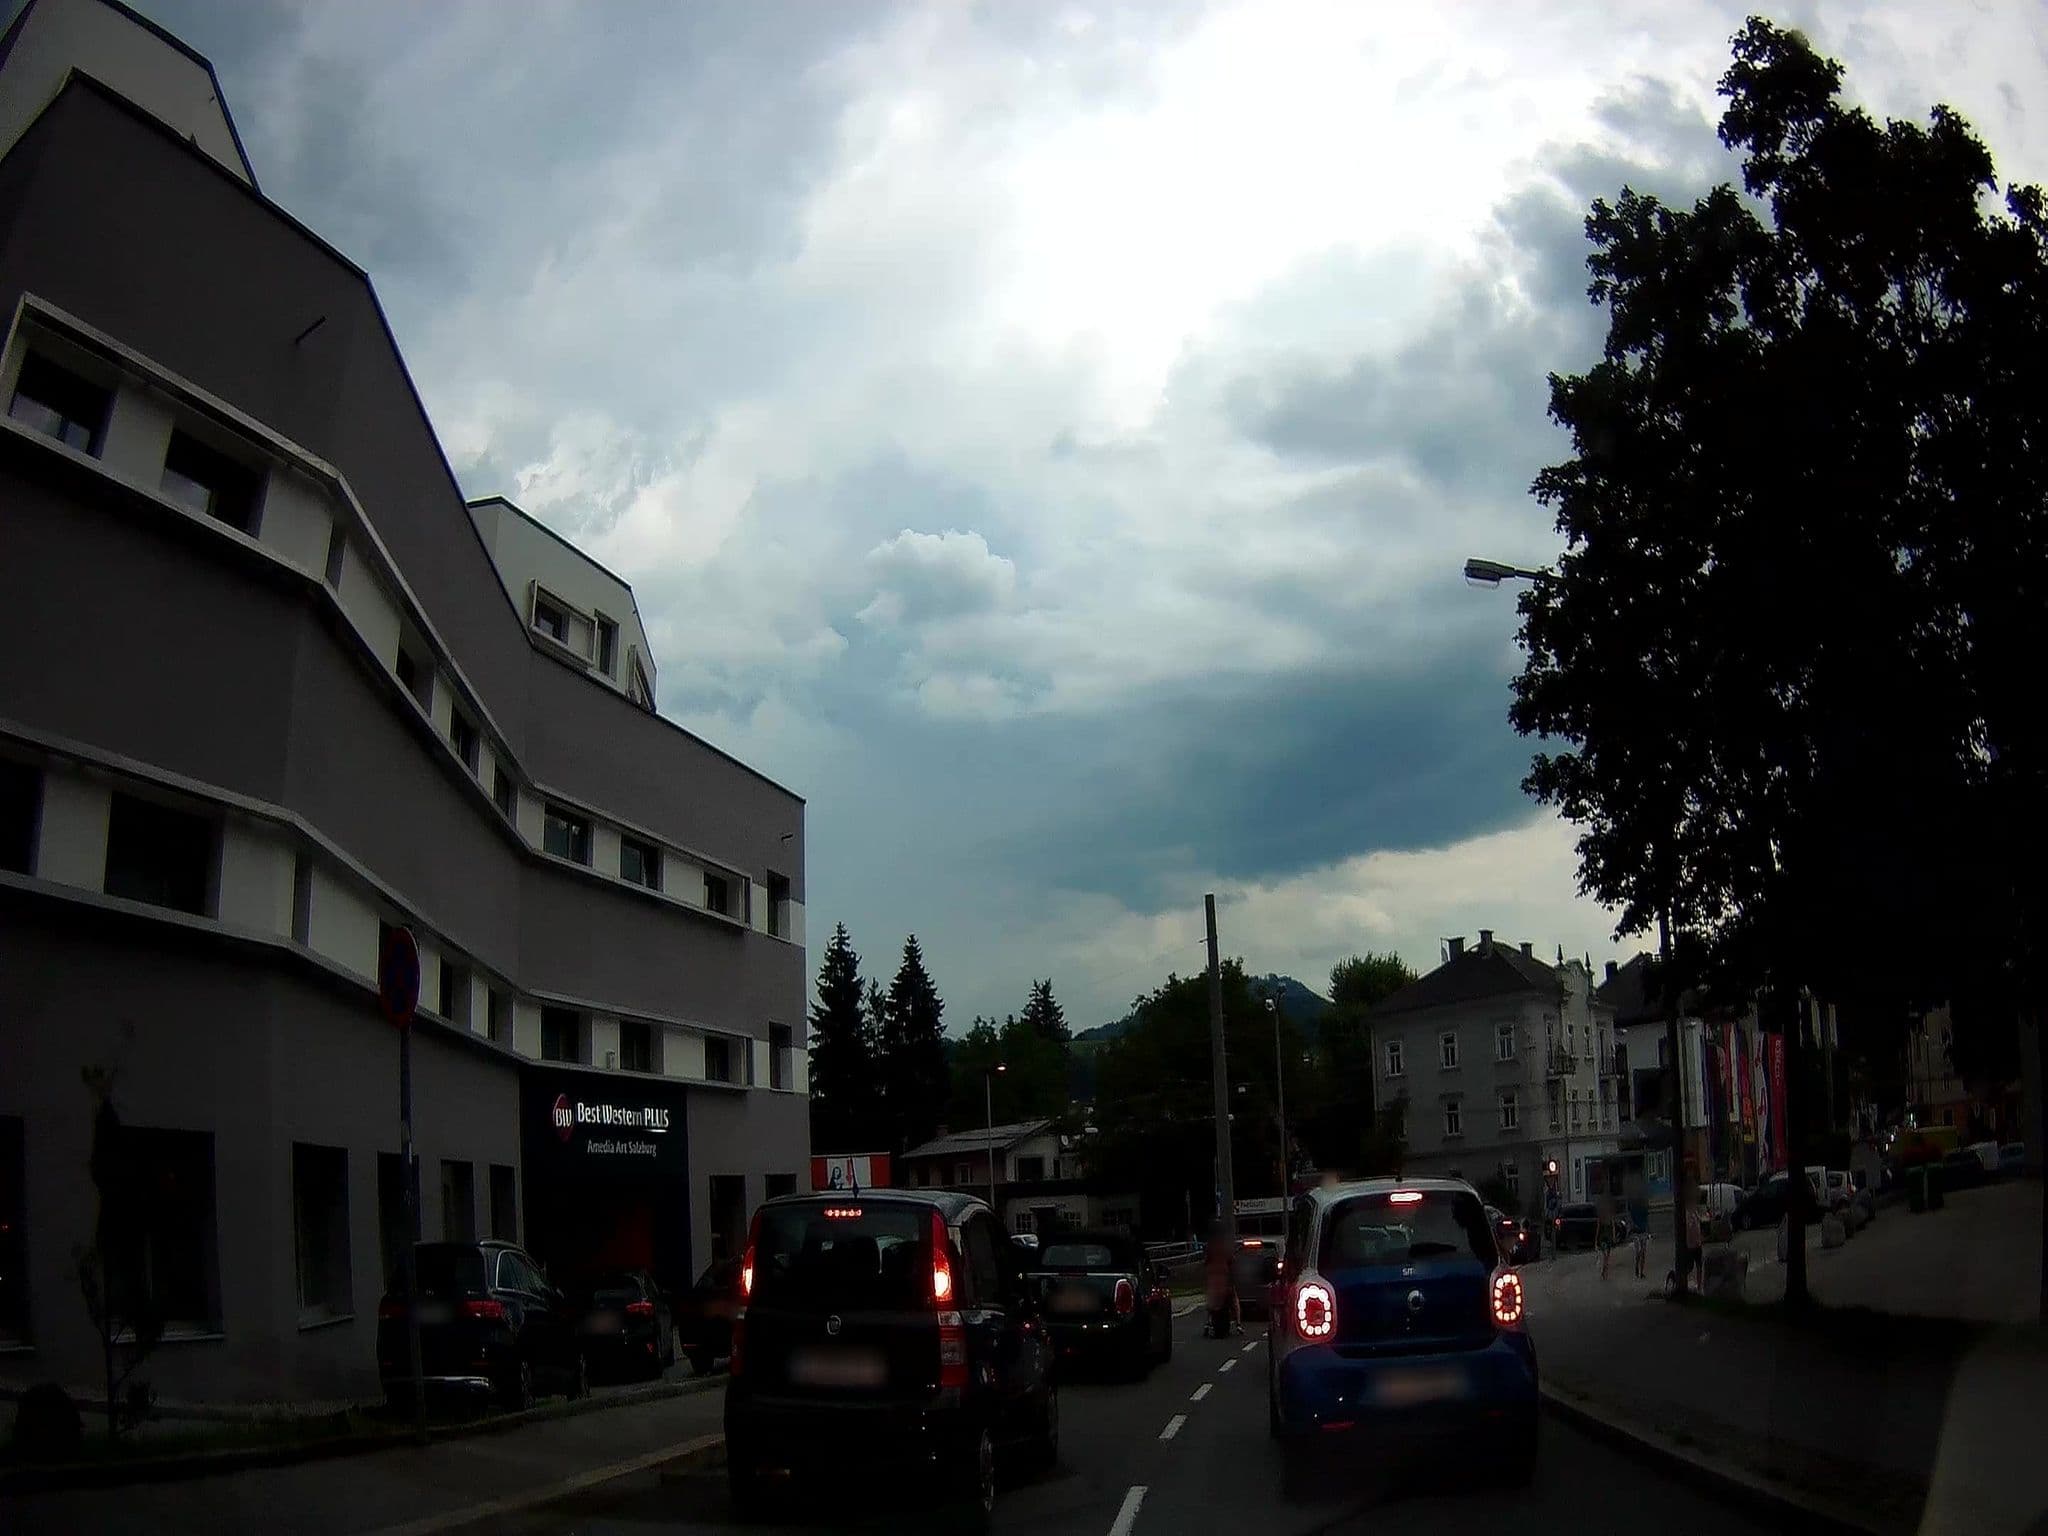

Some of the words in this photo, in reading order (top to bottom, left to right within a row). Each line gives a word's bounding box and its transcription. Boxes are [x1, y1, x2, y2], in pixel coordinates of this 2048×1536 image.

[555, 1108, 573, 1127] BW
[577, 1102, 600, 1124] Best
[602, 1104, 642, 1126] Western
[644, 1107, 670, 1128] PLUS
[615, 1140, 628, 1155] Art
[629, 1141, 657, 1157] Salzburg
